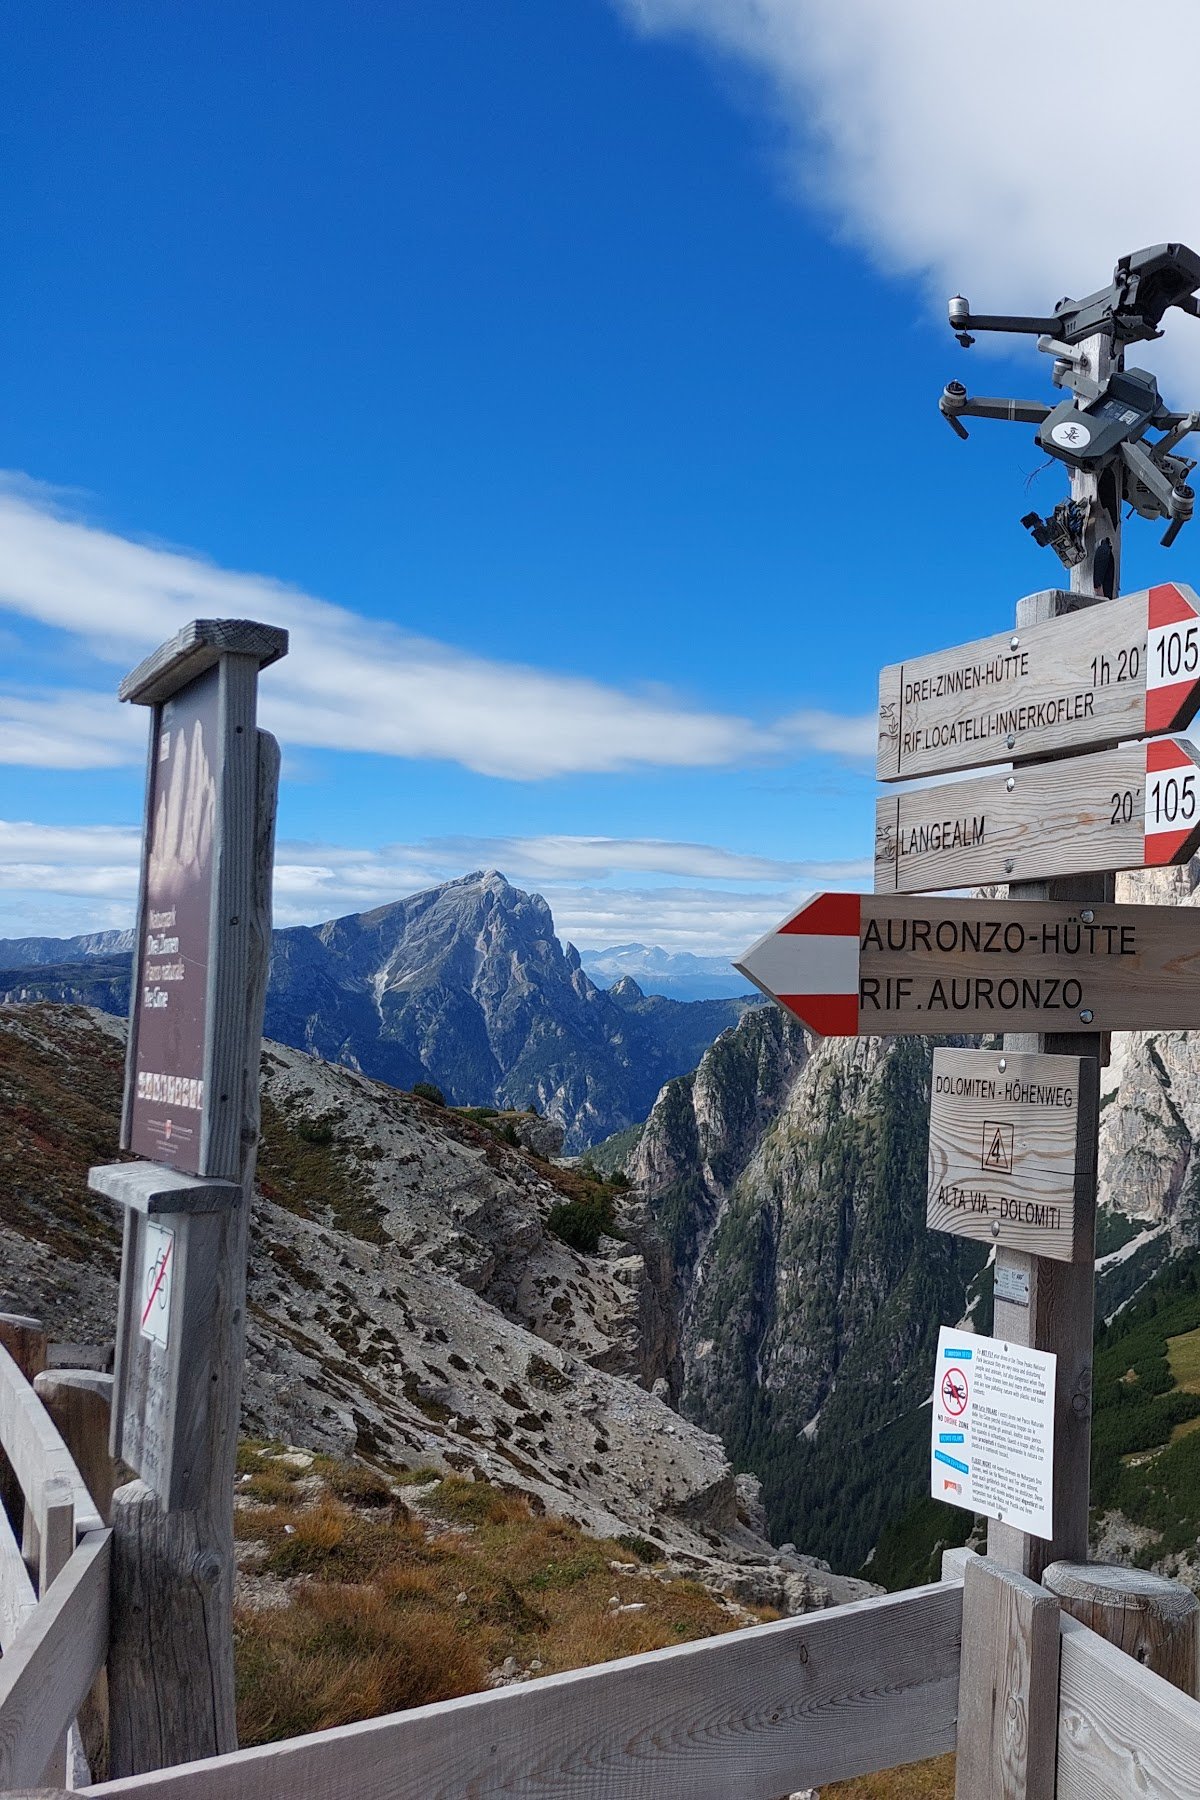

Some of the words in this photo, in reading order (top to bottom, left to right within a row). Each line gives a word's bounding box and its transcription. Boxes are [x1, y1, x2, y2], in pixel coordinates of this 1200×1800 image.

[1156, 627, 1199, 678] 105
[906, 652, 1029, 704] DREI-ZINNEN-HÜTTE
[1090, 656, 1110, 687] 1h
[903, 692, 1094, 753] RIF.LOCATELLI-INNERKOFLER
[1151, 775, 1195, 823] 105
[901, 816, 985, 855] LANGEALM
[861, 917, 1136, 955] AURONZO-HÜTTE
[936, 1076, 995, 1099] DOLOMITEN
[1005, 1079, 1073, 1107] HÖHENWEG
[991, 1139, 1001, 1163] 4
[938, 1185, 966, 1210] ALTA
[970, 1190, 989, 1215] VIA
[1000, 1197, 1061, 1230] DOLOMITI
